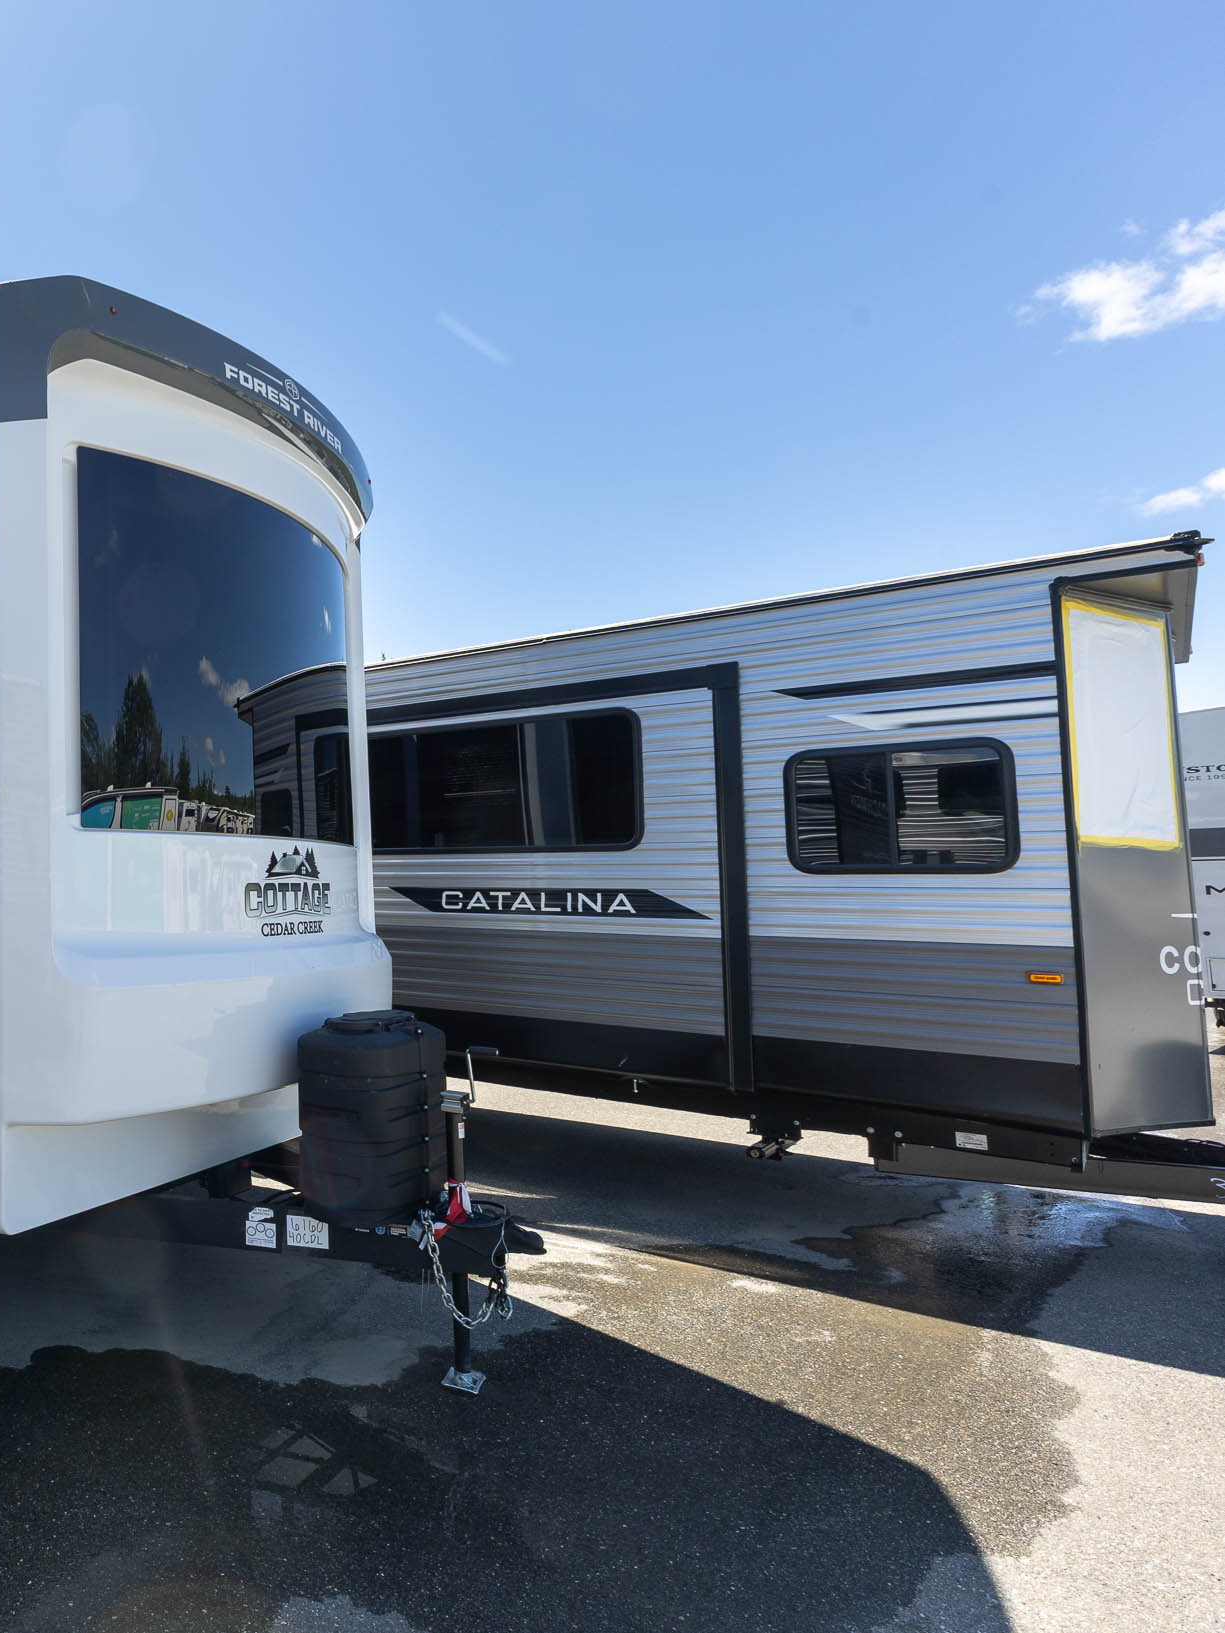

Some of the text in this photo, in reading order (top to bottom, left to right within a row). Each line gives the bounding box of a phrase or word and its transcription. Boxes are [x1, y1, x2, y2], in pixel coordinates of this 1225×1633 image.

[224, 361, 342, 453] FOREST RIVER
[244, 881, 332, 919] COTTAGE
[441, 890, 637, 914] CATALINA
[261, 920, 324, 937] CEDAR CREEK
[290, 1217, 324, 1234] 6160
